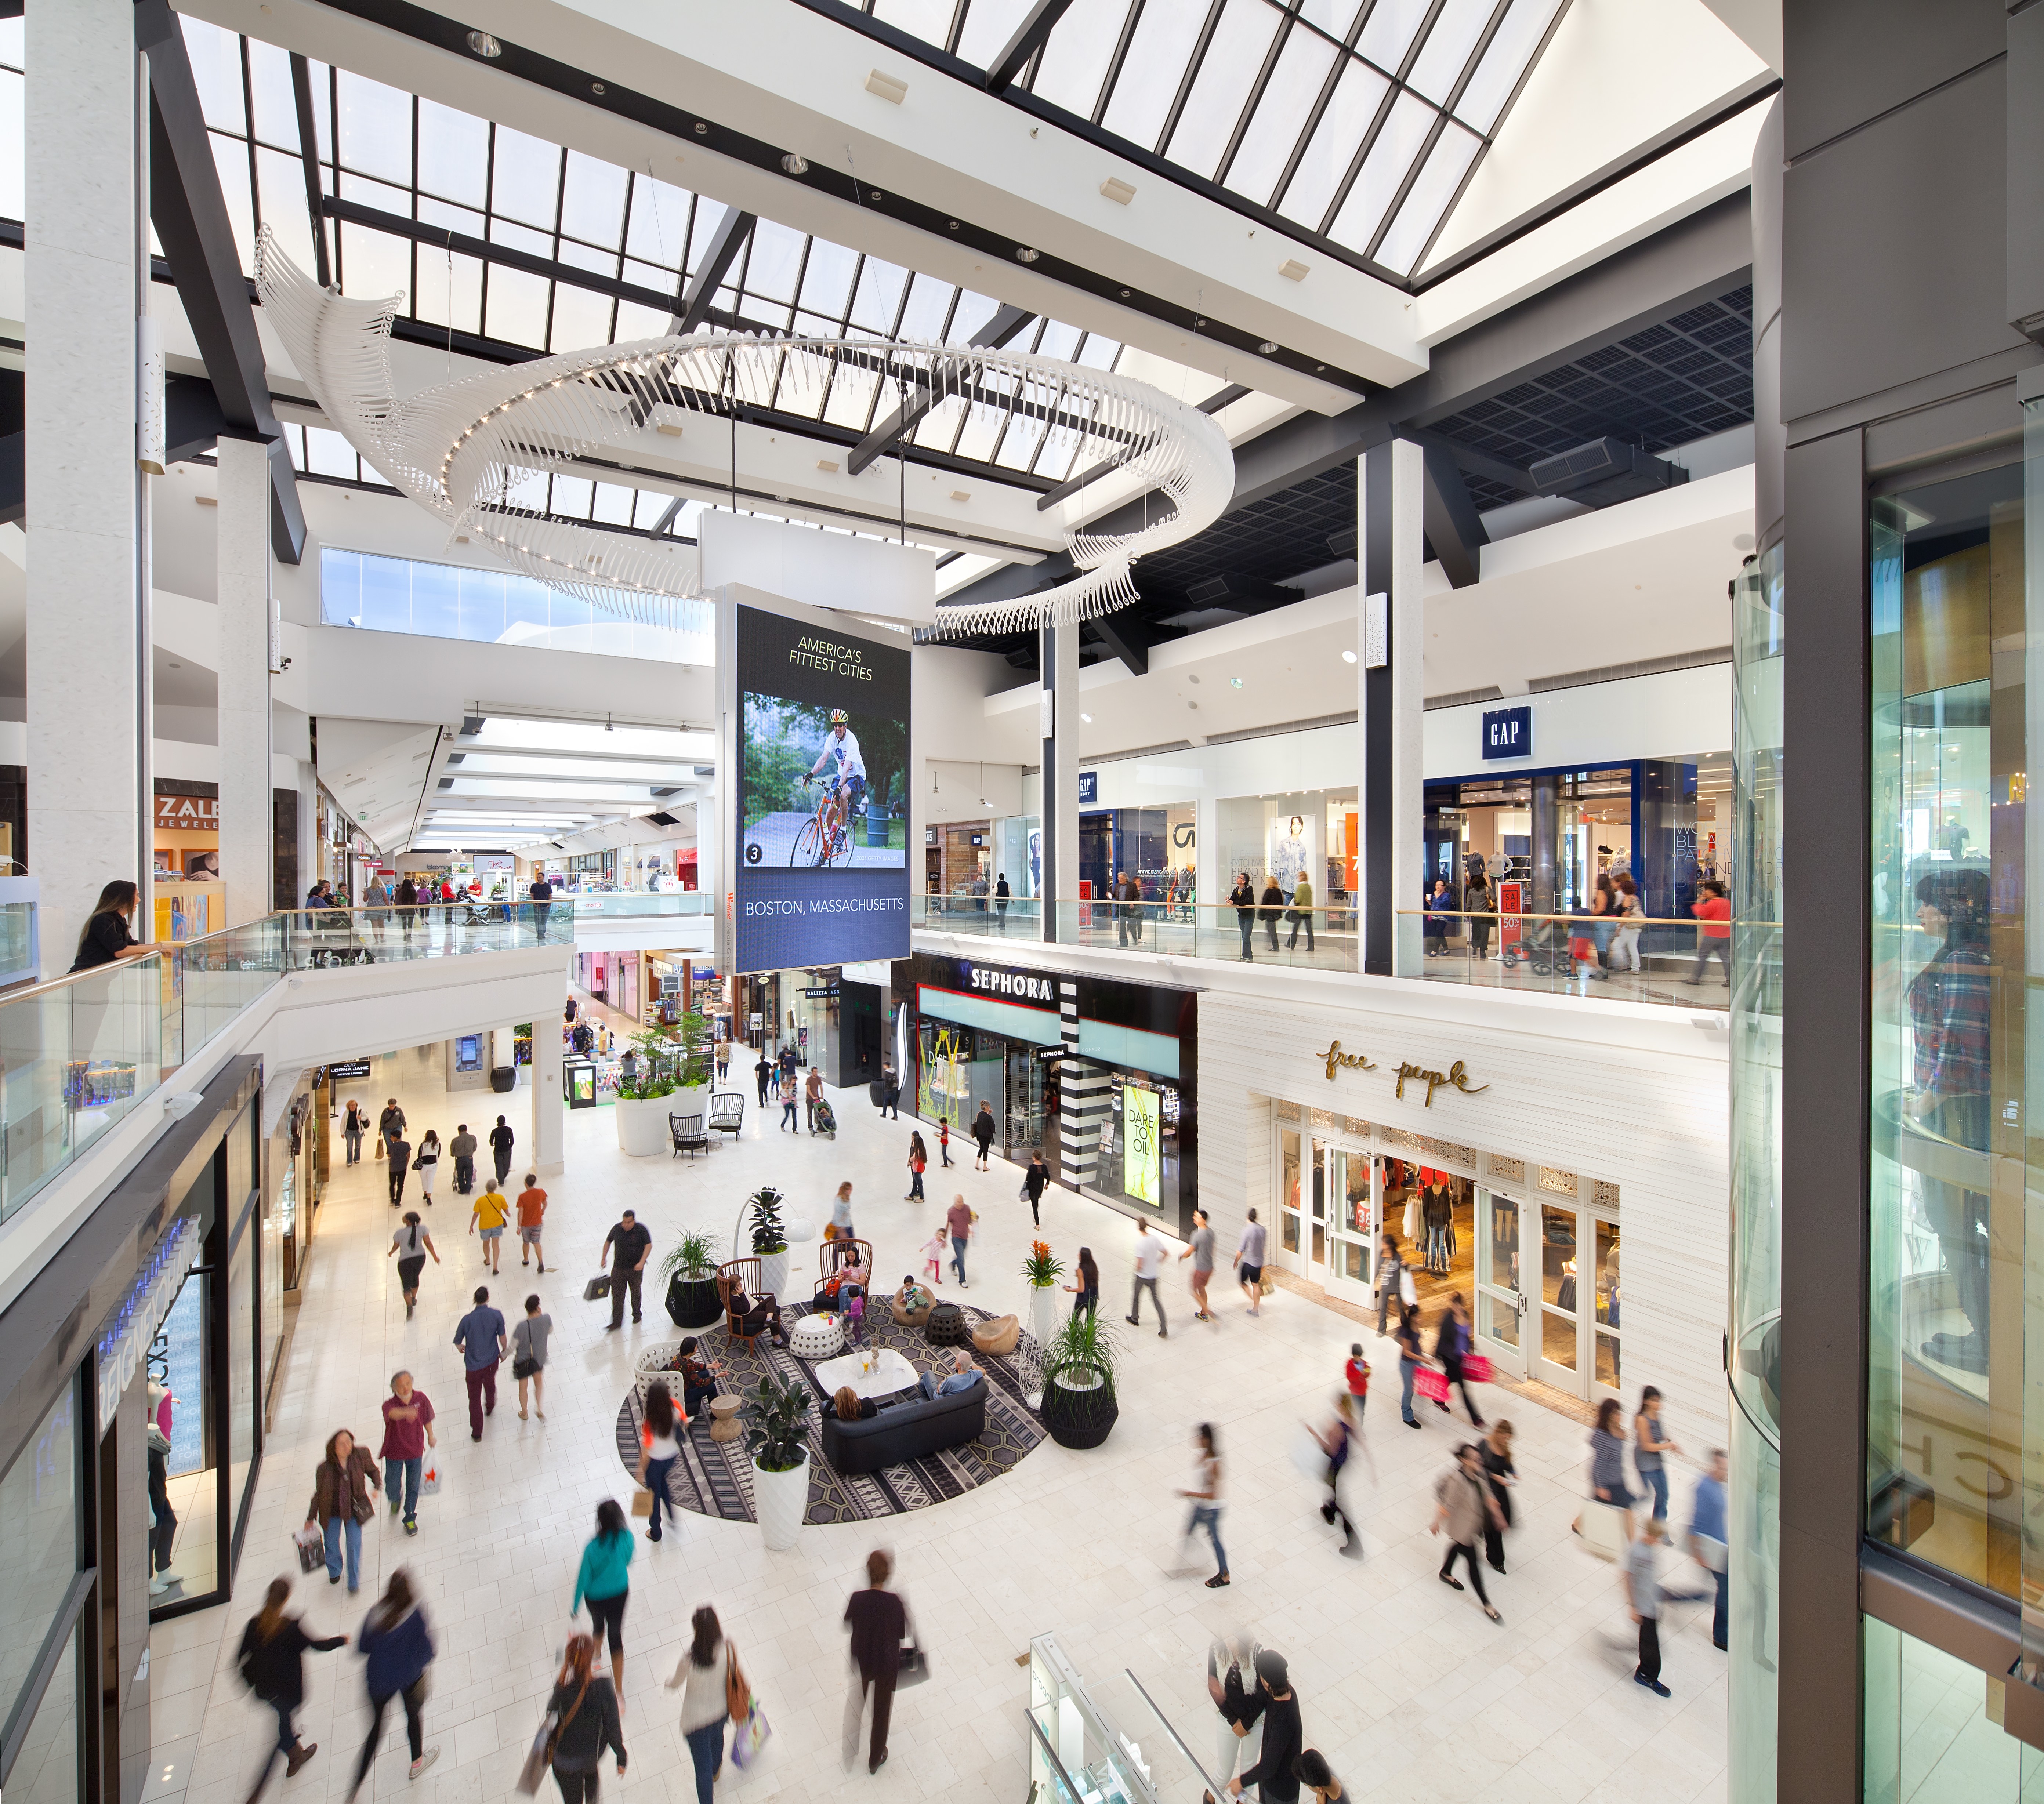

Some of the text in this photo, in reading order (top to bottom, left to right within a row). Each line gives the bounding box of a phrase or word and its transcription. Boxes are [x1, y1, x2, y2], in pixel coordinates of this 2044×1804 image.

[798, 636, 862, 663] AMERICA'S
[790, 650, 873, 681] FITTEST CITIES
[1491, 721, 1518, 745] GAP
[1080, 778, 1090, 791] GAP
[1676, 821, 1727, 834] WORN
[1676, 834, 1731, 848] BLEAC
[750, 847, 758, 860] 3
[488, 860, 503, 869] Joe's
[1232, 867, 1285, 876] RIP AND REPAIR
[746, 897, 903, 916] BOSTON, MASSACHUSETTS
[1503, 918, 1519, 928] 50%
[972, 969, 1051, 1001] SEPHORA
[1316, 1040, 1490, 1108] free people
[1129, 1109, 1153, 1129] DARE
[1134, 1125, 1148, 1140] TO
[1133, 1139, 1149, 1155] OIL
